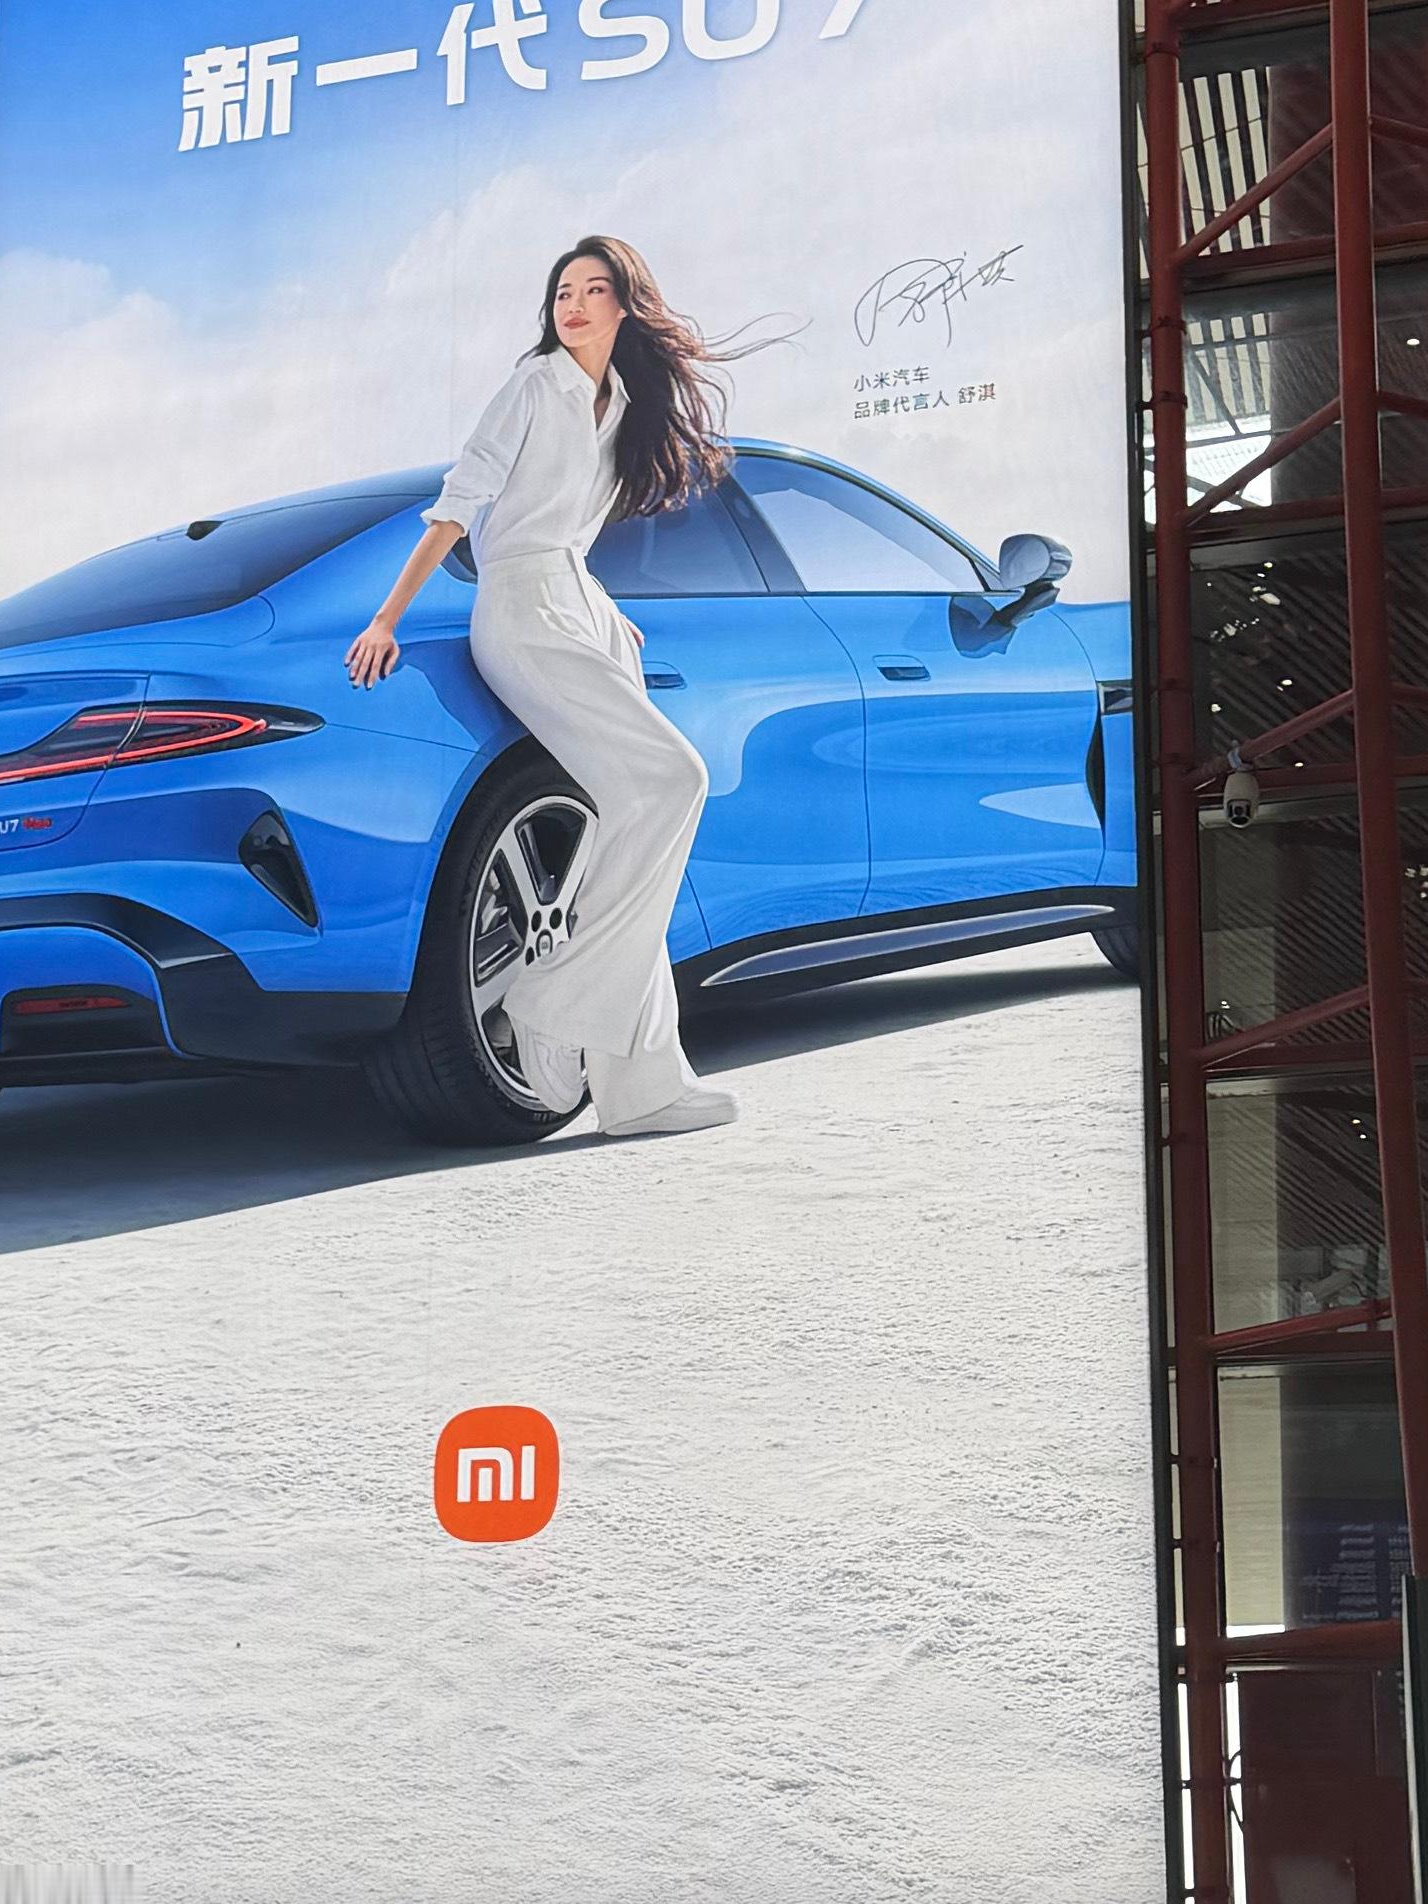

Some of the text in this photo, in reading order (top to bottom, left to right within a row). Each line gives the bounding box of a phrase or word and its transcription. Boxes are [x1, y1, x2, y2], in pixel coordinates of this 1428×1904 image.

[853, 366, 930, 392] 小米汽车
[854, 383, 997, 419] 品牌代言人 舒淇
